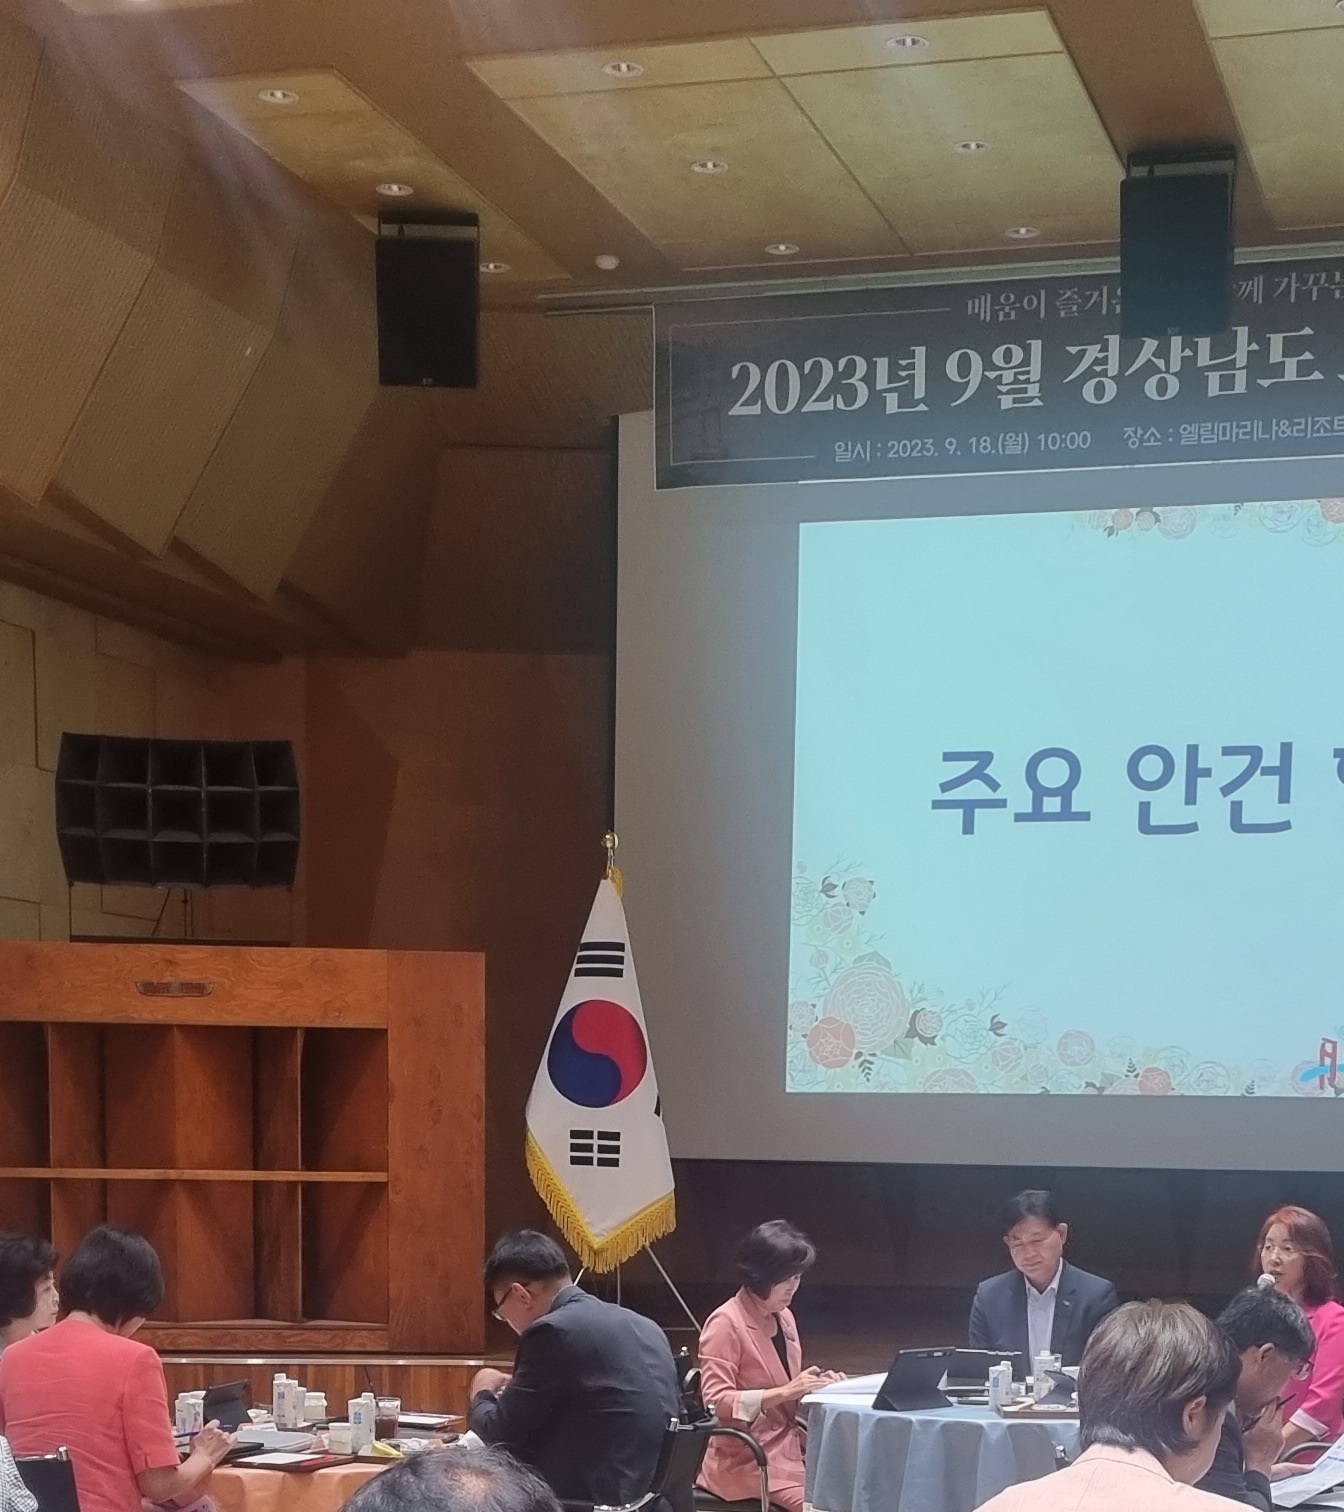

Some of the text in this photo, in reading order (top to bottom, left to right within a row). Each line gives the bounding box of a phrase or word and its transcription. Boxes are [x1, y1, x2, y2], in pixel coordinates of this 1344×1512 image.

[967, 288, 1046, 322] 배움이
[1056, 284, 1121, 318] 즐거
[727, 345, 929, 416] 2023년
[945, 339, 1044, 410] 9월
[1062, 325, 1325, 404] 경상남도
[834, 439, 871, 463] 일시
[887, 437, 939, 458] 2023.
[944, 437, 961, 456] 9.
[1037, 431, 1092, 451] 10:00
[1123, 425, 1162, 449] 장소
[930, 745, 1093, 836] 주요
[1125, 739, 1295, 836] 안건
